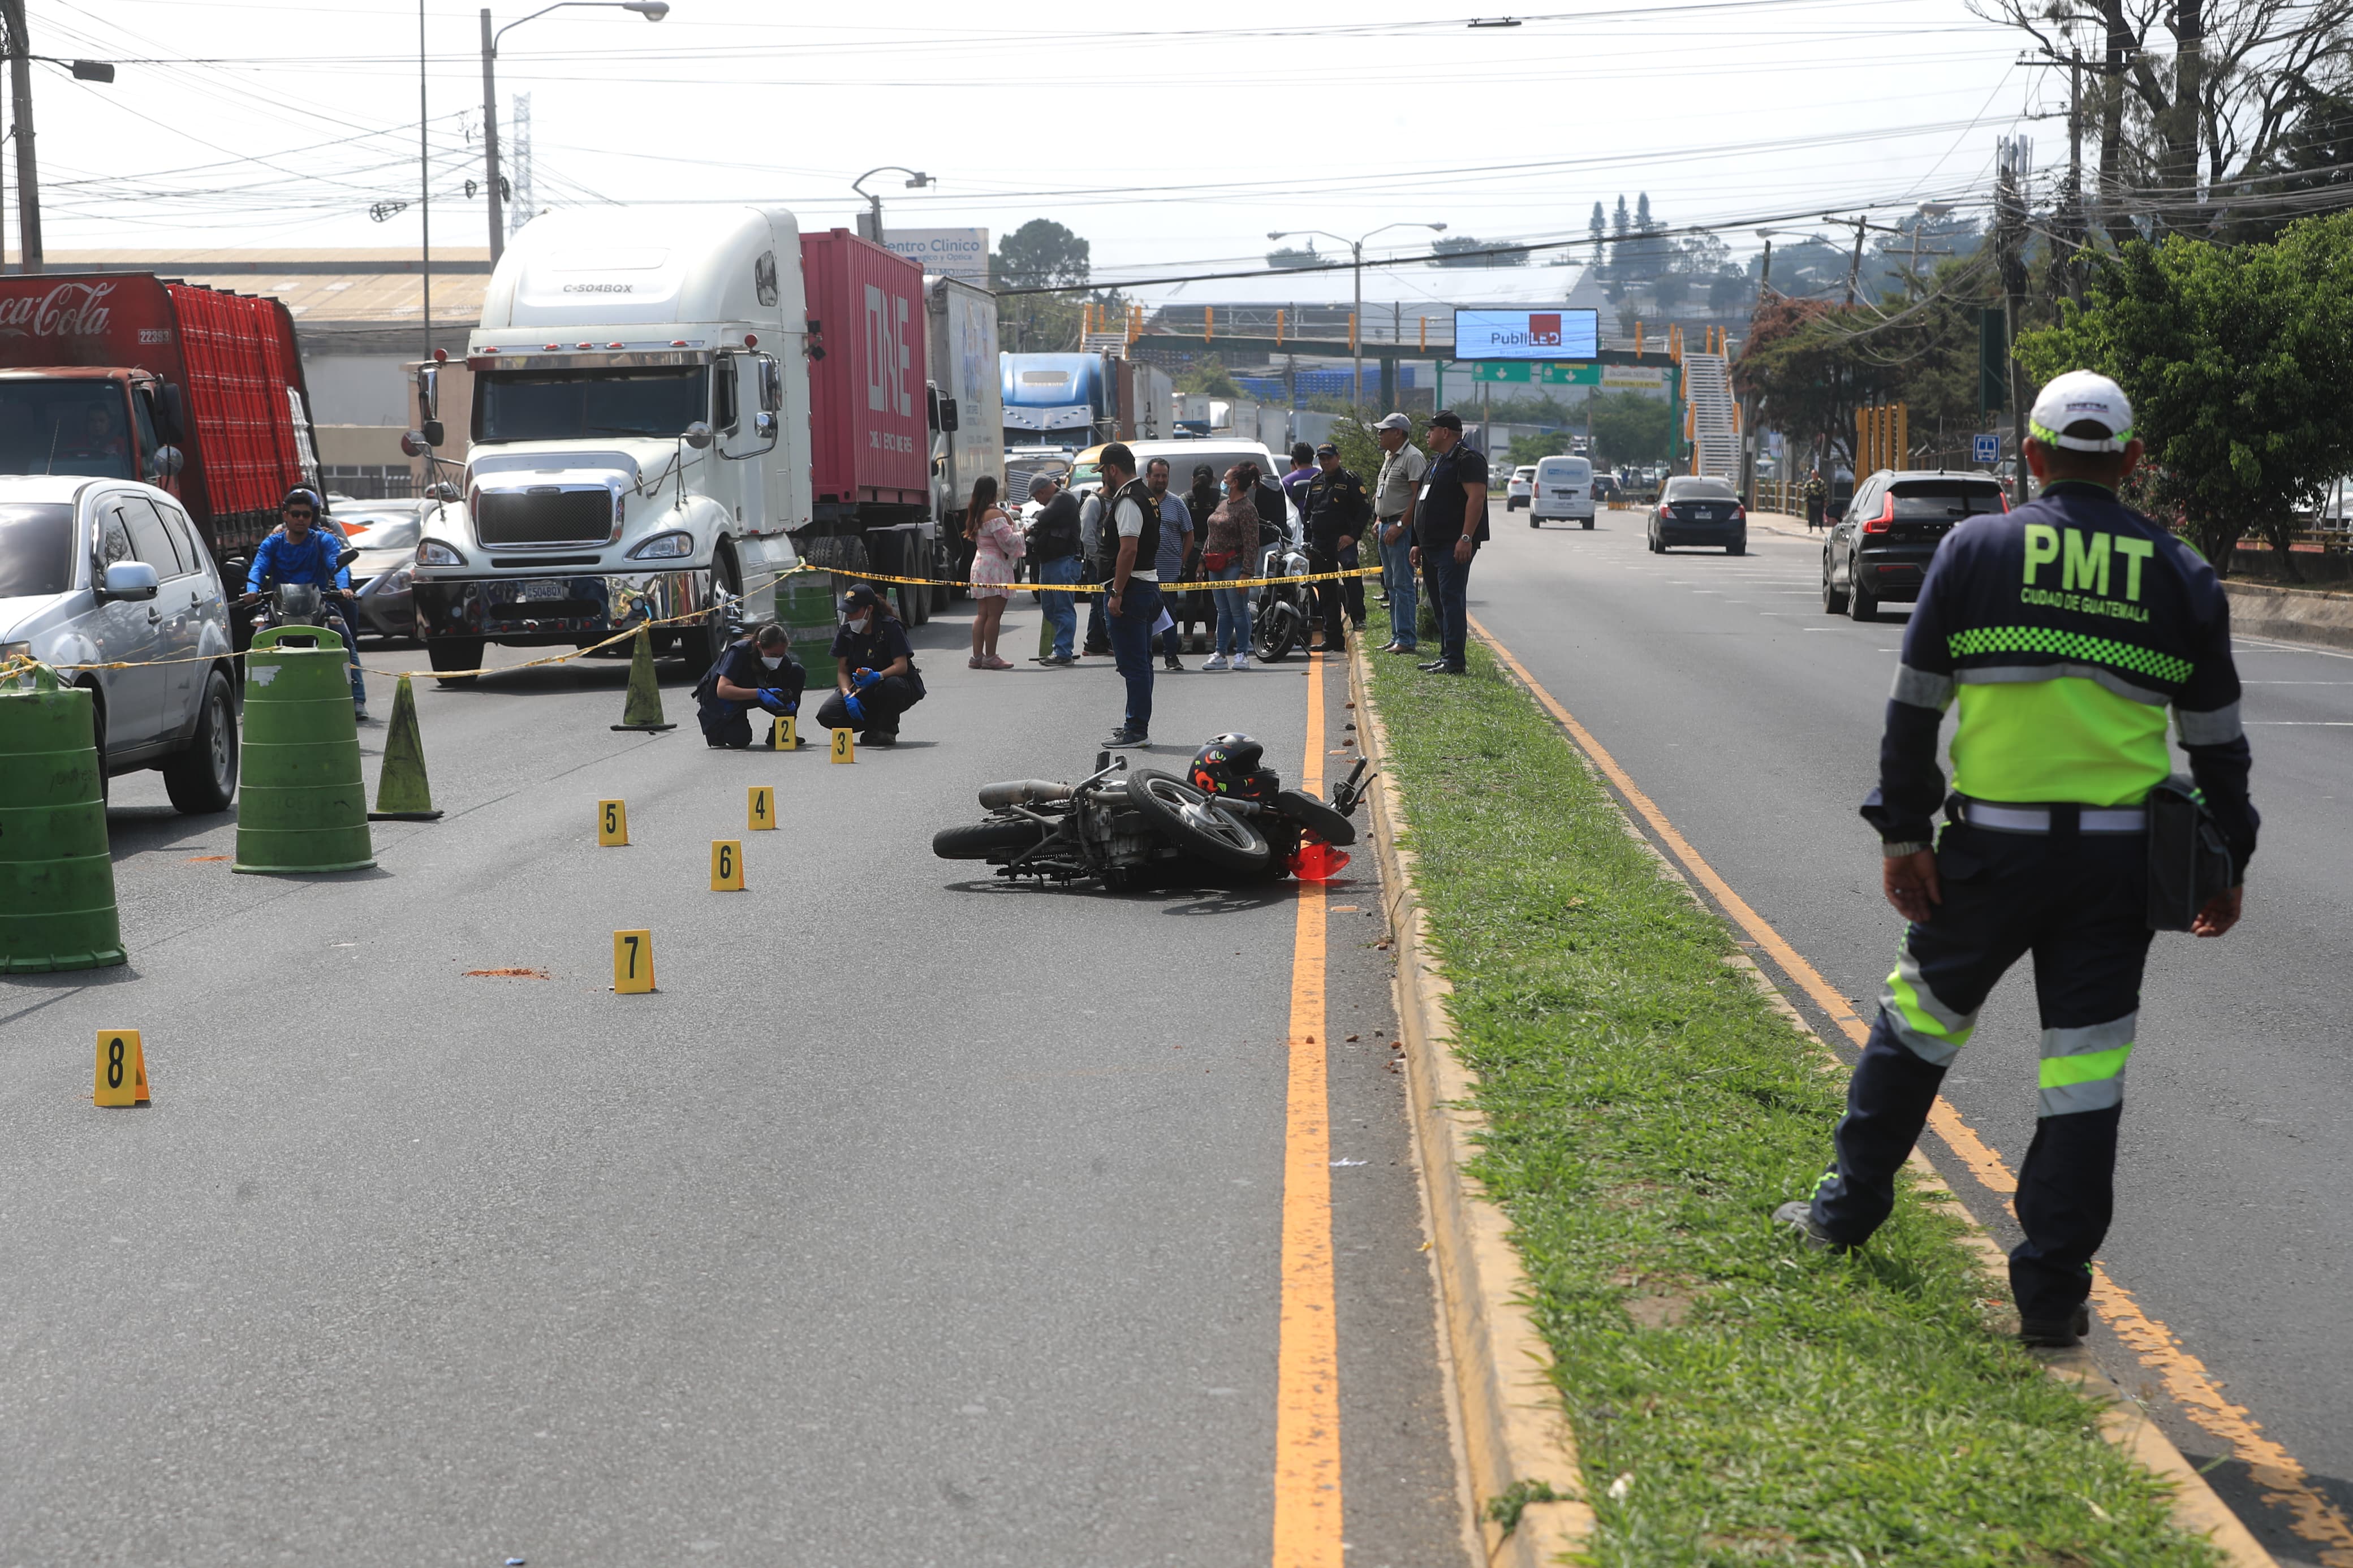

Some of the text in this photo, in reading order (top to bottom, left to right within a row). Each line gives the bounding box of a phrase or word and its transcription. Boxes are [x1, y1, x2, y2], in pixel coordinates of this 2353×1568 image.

[884, 239, 926, 252] entro
[563, 284, 634, 293] C-504BQX
[140, 331, 170, 343] 22393
[865, 283, 912, 418] ONE
[2023, 524, 2154, 602] PMT
[2020, 587, 2149, 623] CIUDAD DE GUATEMALA
[781, 720, 789, 742] 2
[837, 732, 846, 755] 3
[606, 804, 616, 833] 5
[756, 791, 765, 819] 4
[720, 845, 731, 879] 6
[624, 936, 638, 979] 7
[108, 1038, 124, 1088] 8
